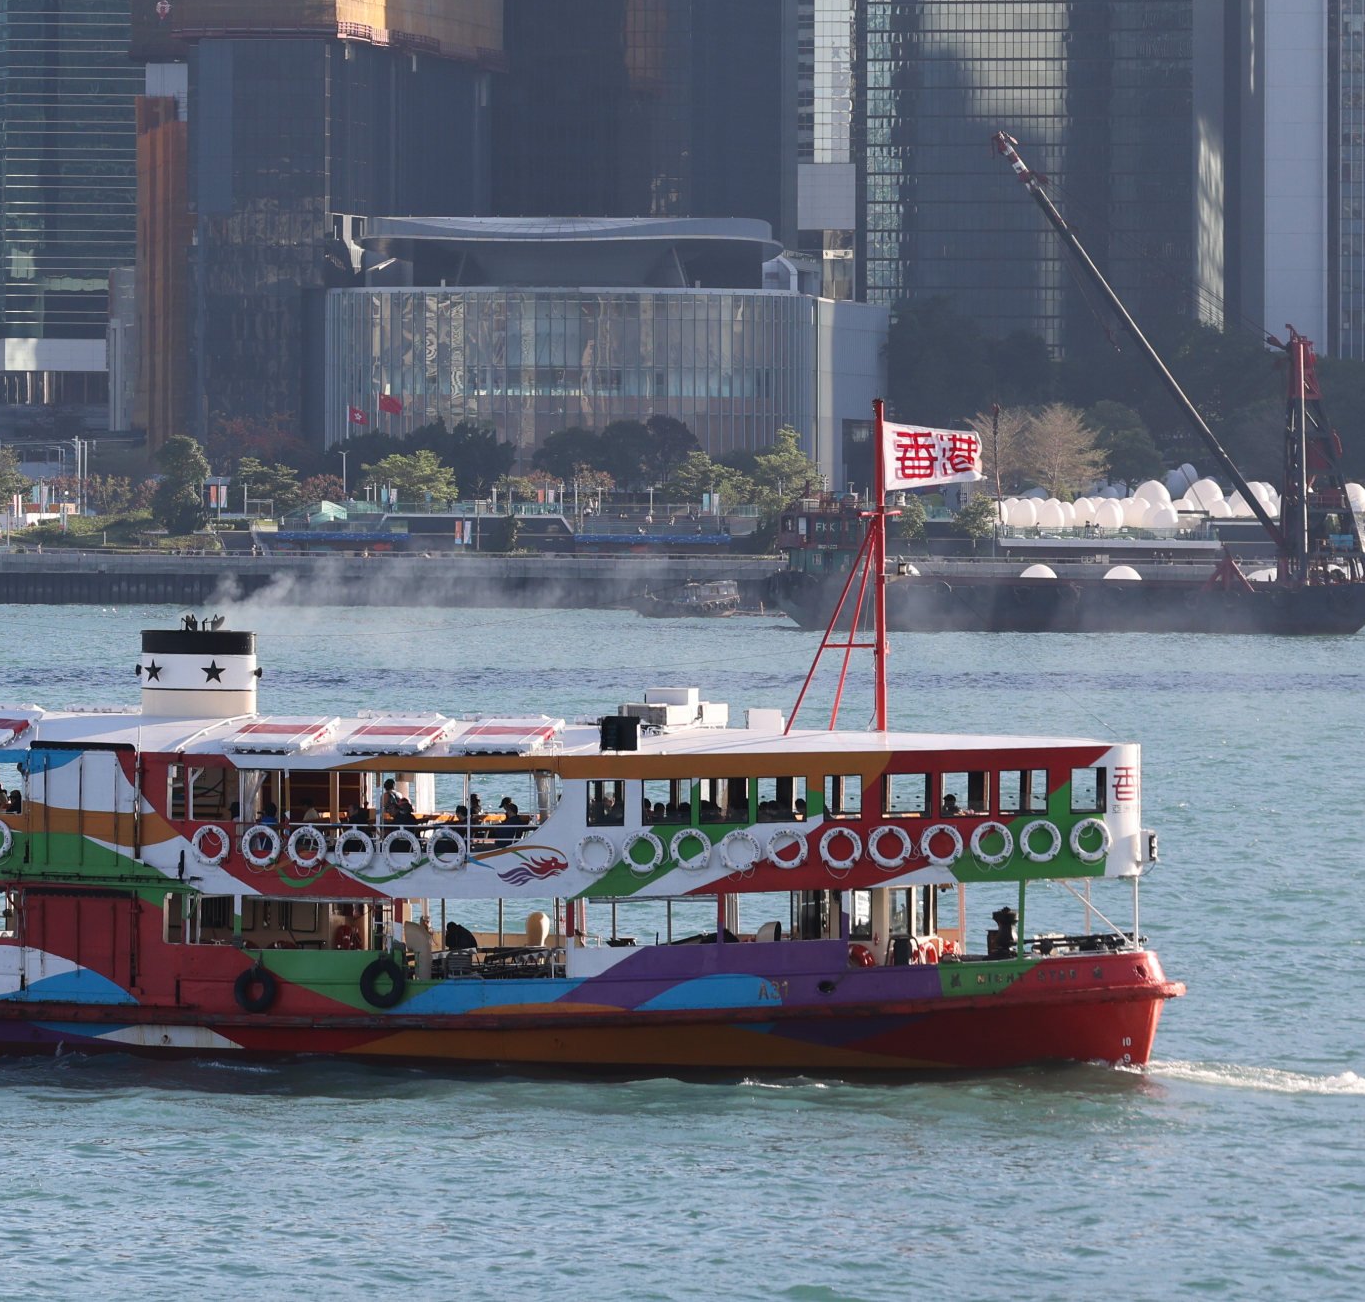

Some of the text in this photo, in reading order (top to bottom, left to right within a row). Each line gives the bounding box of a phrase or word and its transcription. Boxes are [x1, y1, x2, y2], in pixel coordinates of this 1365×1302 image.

[895, 431, 978, 478] 香港
[1123, 1037, 1131, 1046] 10
[1124, 1053, 1131, 1063] 9
